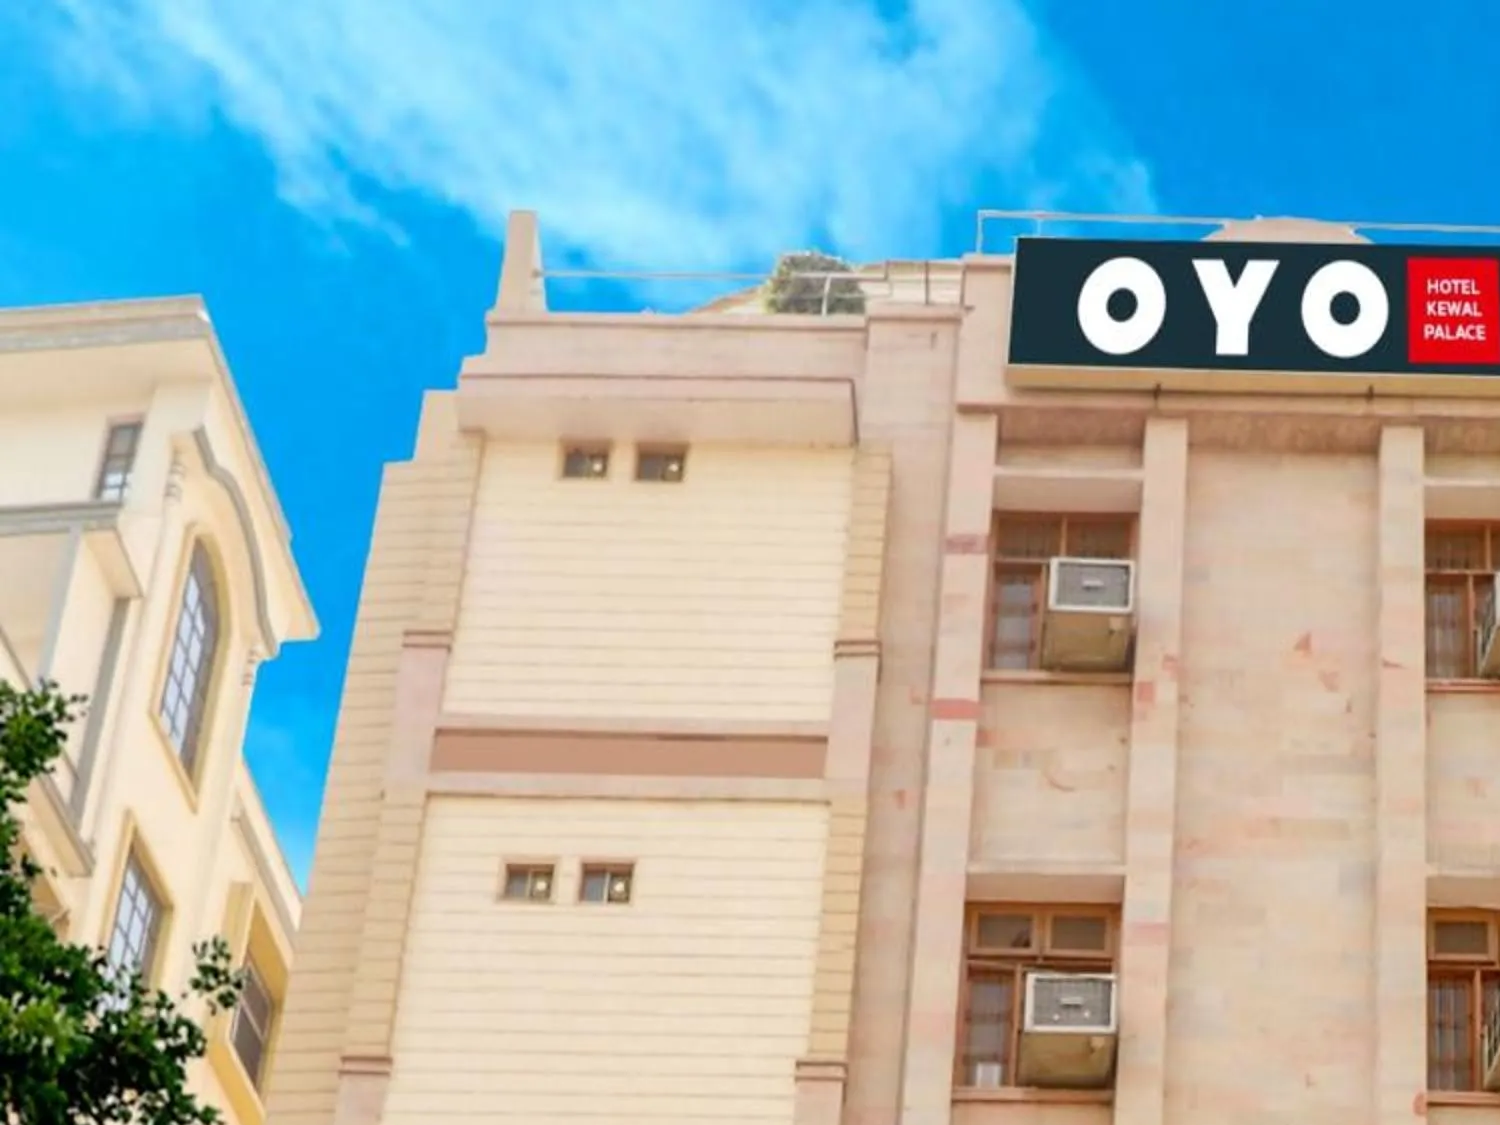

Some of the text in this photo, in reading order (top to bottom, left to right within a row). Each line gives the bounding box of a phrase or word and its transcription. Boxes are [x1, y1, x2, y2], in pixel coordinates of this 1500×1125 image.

[1426, 278, 1481, 295] HOTEL
[1077, 256, 1389, 359] OYO
[1425, 300, 1483, 317] KEWAL
[1423, 323, 1486, 341] PALACE
